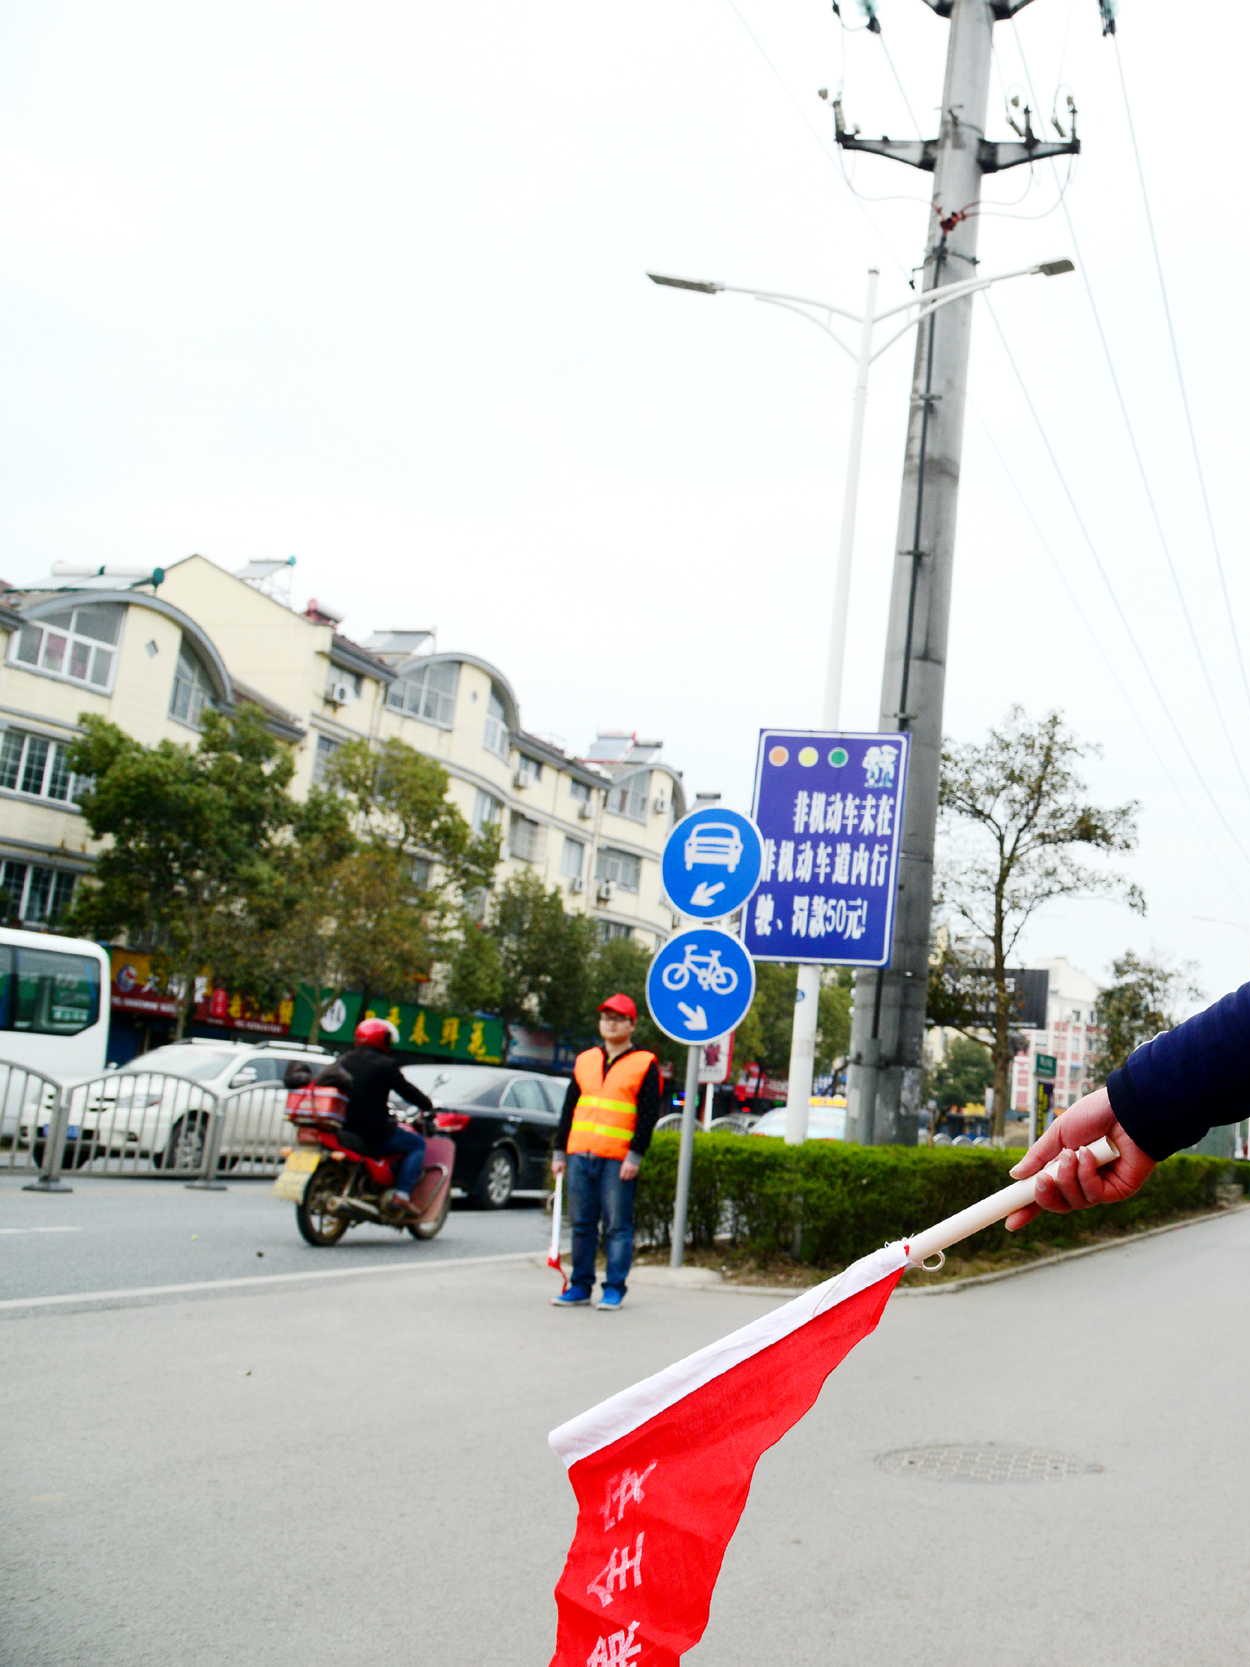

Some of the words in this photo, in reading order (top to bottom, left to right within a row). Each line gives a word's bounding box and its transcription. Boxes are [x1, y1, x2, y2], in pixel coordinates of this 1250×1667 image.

[792, 789, 895, 838] 非机动车未在
[760, 838, 889, 887] 非机动车道内行
